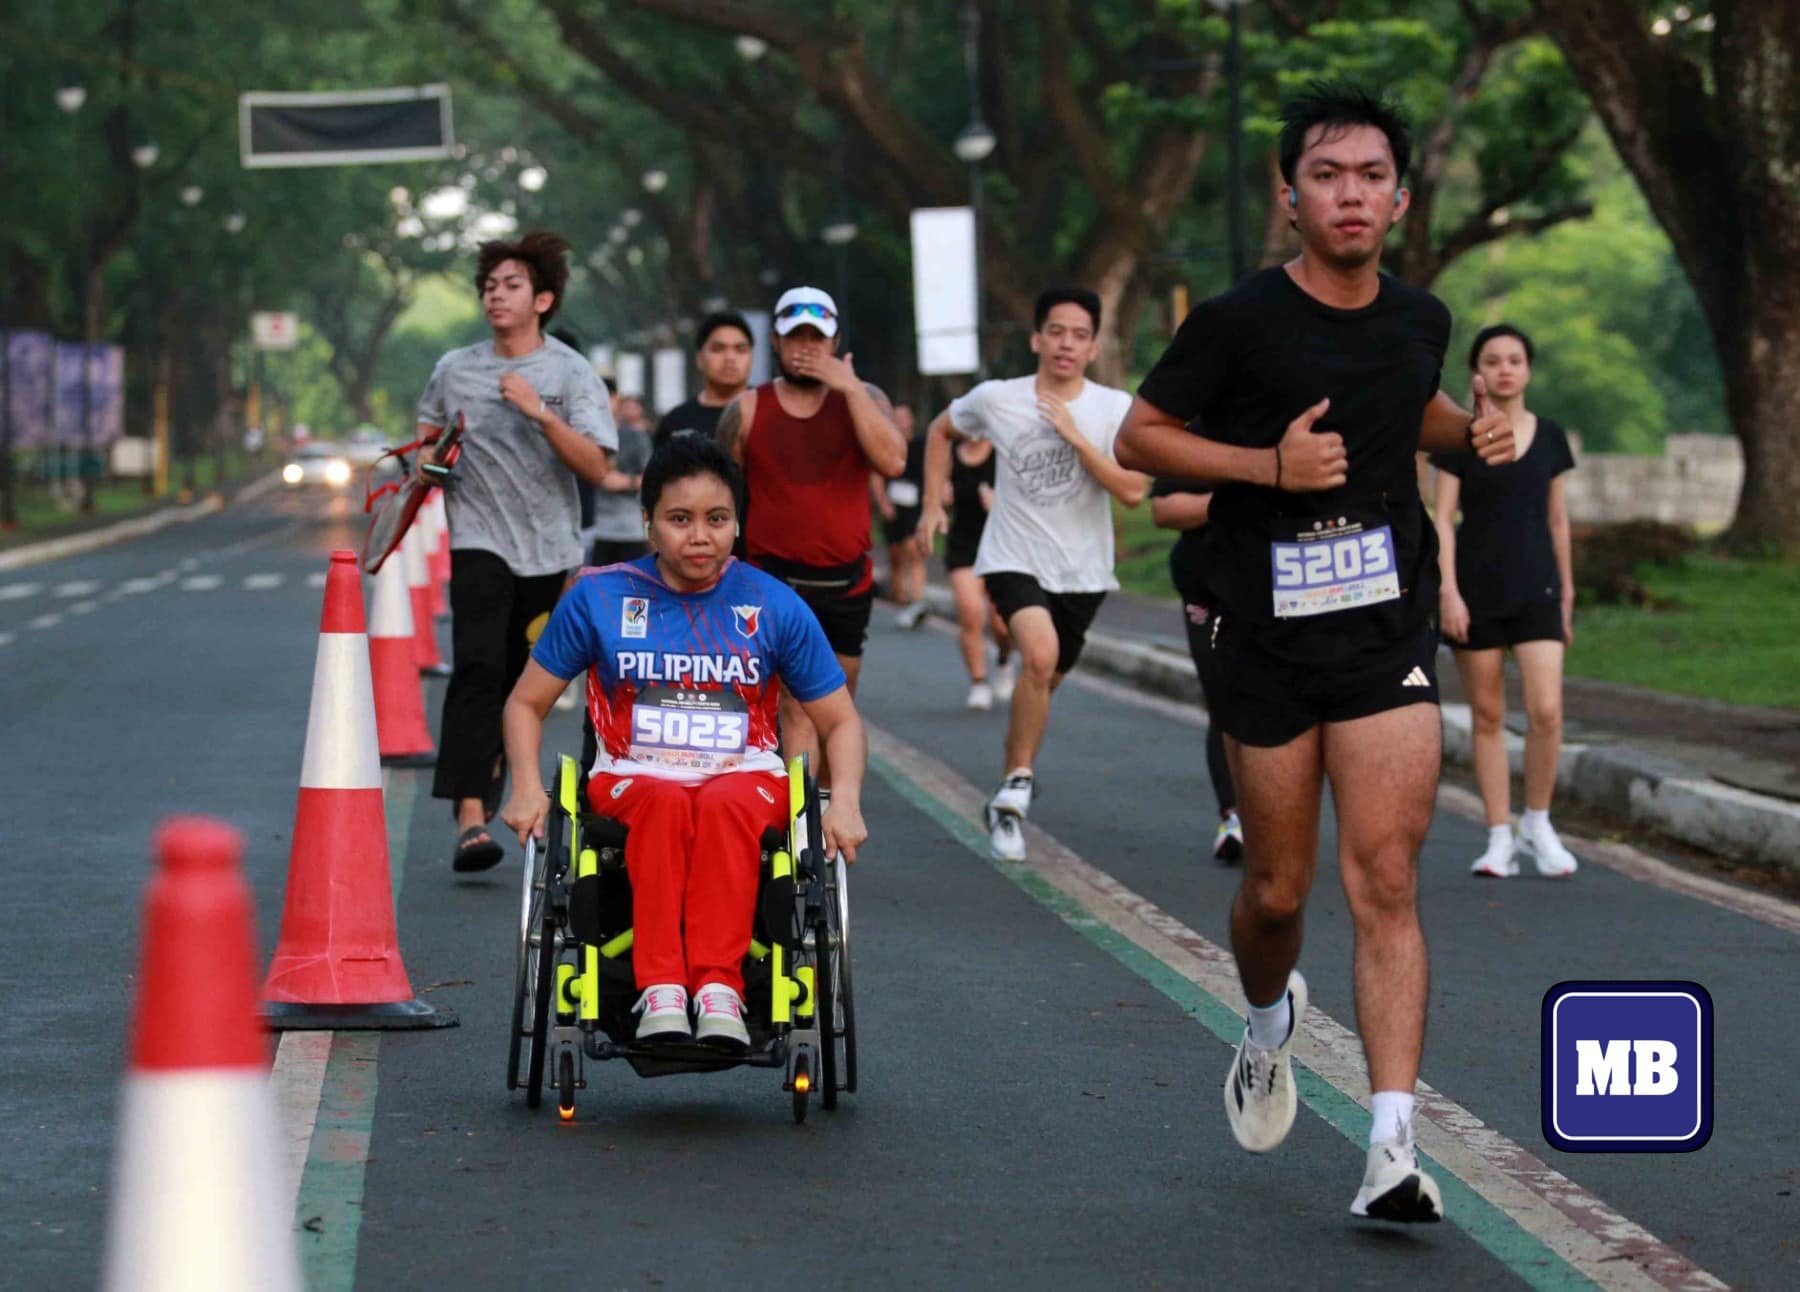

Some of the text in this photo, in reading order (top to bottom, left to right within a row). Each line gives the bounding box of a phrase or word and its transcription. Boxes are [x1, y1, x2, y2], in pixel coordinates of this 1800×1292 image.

[1276, 532, 1389, 586] 5203
[617, 652, 760, 685] PILIPINAS
[636, 708, 742, 749] 5023
